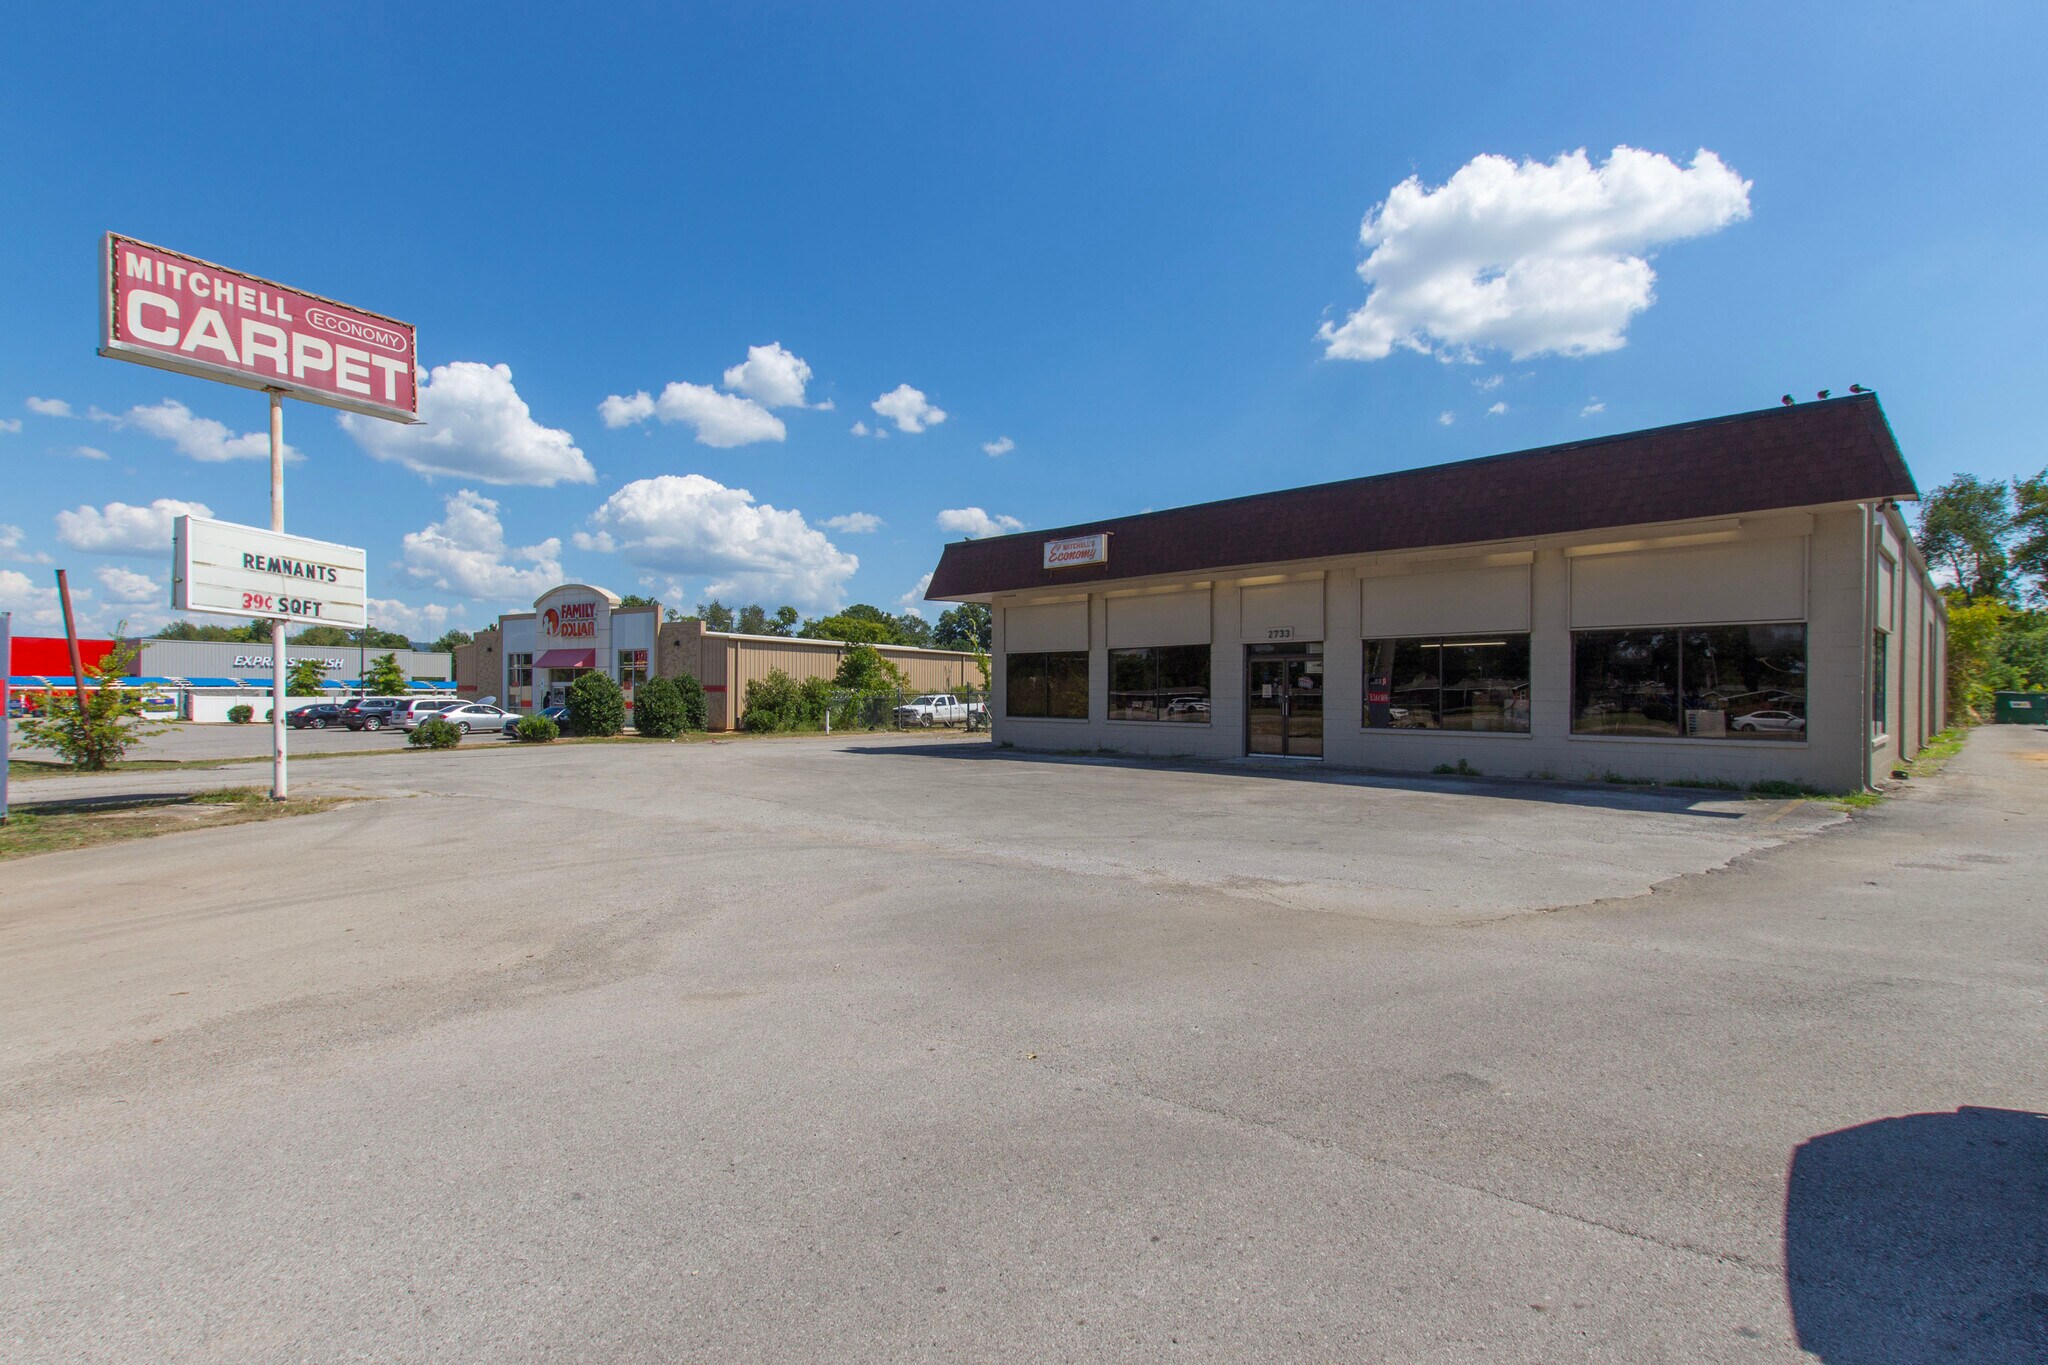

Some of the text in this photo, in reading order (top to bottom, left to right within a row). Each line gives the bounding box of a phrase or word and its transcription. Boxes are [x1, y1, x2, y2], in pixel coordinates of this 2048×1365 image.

[125, 251, 293, 322] MITCHELL
[313, 313, 401, 347] ECONOMY
[126, 289, 409, 401] CARPET
[1048, 543, 1097, 562] Economy
[242, 553, 337, 582] REMNANTS
[242, 592, 323, 617] 39¢ SQFT
[561, 603, 596, 619] FAMILY
[561, 621, 596, 637] DOLLAR
[1268, 629, 1290, 639] 2733
[233, 655, 296, 667] EXPRS
